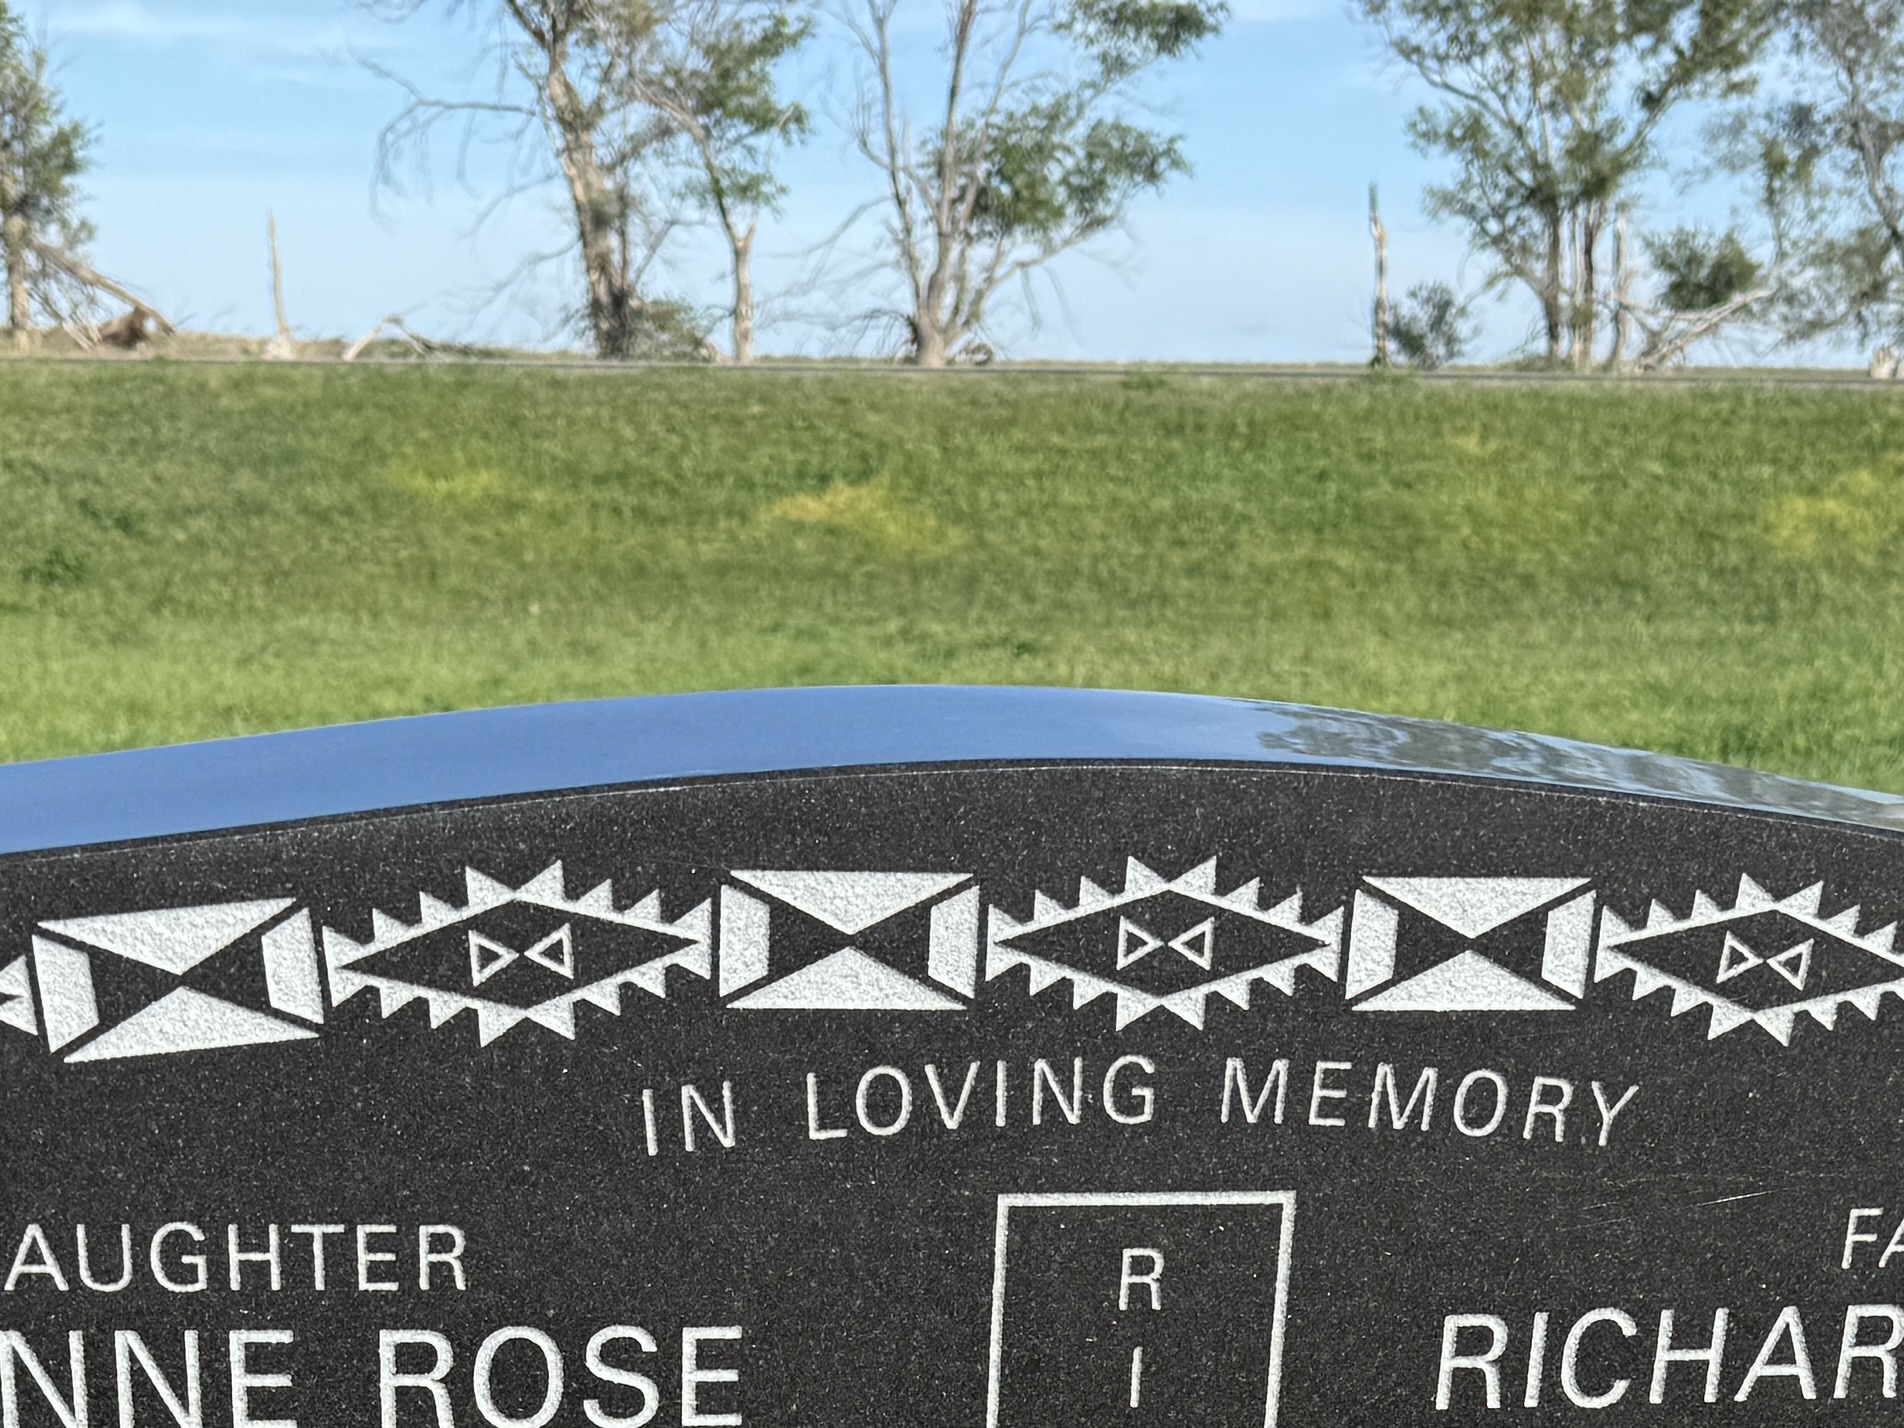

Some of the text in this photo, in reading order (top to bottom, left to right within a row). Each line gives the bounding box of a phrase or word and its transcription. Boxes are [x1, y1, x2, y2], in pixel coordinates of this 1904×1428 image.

[642, 1055, 1639, 1156] IN LOVING MEMORY
